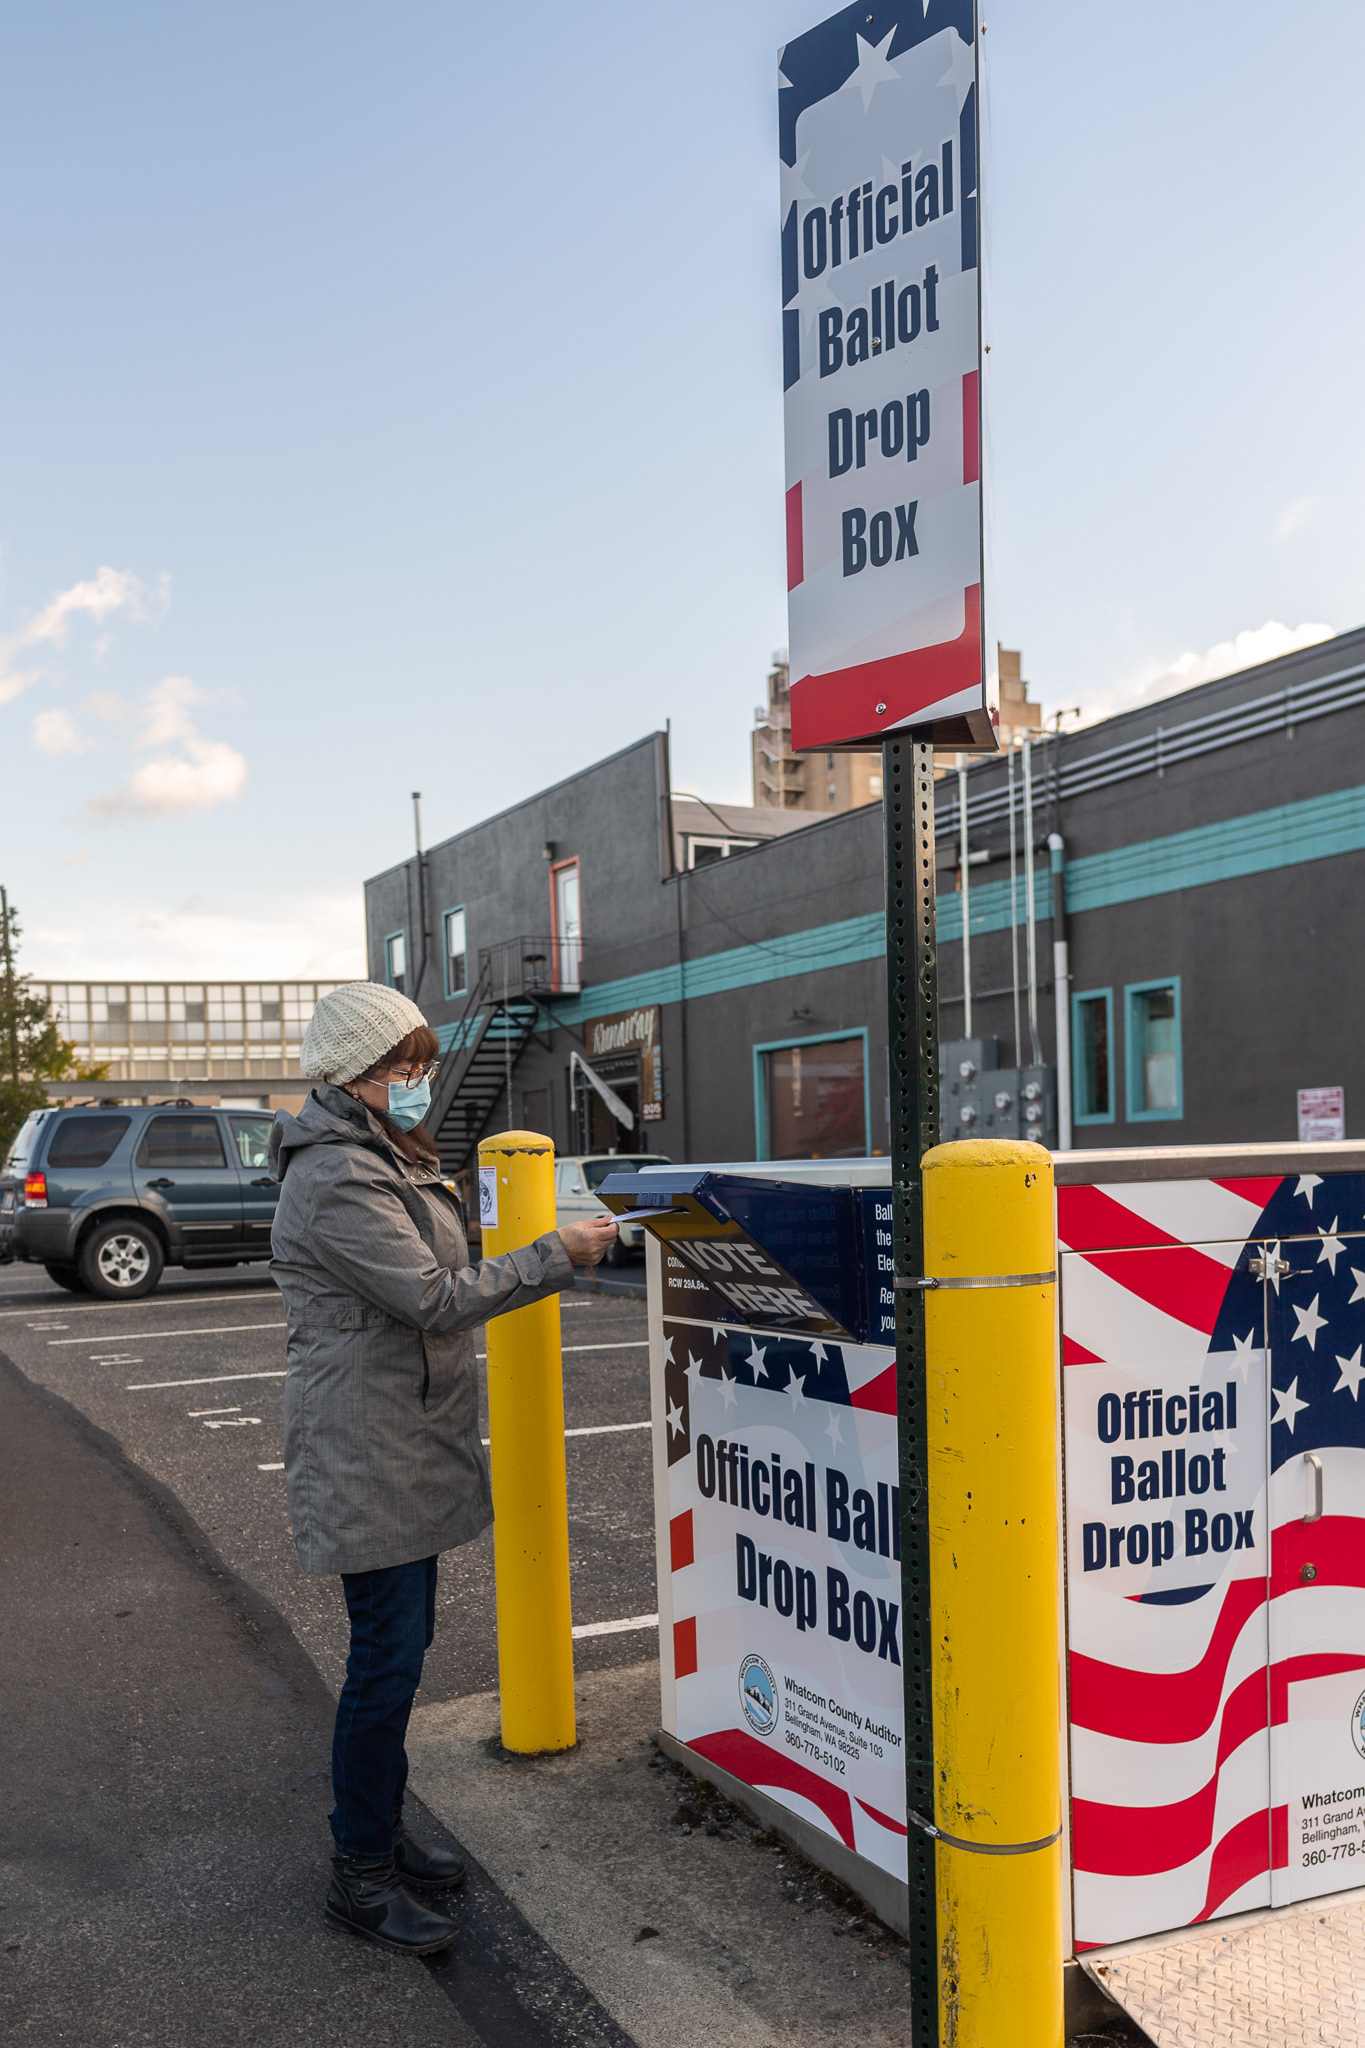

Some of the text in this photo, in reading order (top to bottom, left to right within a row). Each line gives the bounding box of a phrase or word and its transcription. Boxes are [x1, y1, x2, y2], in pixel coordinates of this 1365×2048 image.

[803, 139, 954, 280] Official
[819, 264, 940, 379] Ballot
[828, 388, 930, 479] Drop
[842, 500, 920, 578] Box
[653, 1045, 662, 1100] PRESS
[875, 1204, 893, 1220] Ball
[876, 1229, 892, 1246] the
[668, 1278, 682, 1288] RCW
[669, 1240, 781, 1276] VOTE
[714, 1281, 828, 1320] HERE
[1098, 1382, 1237, 1444] Official
[696, 1434, 901, 1562] Official Ball
[1111, 1448, 1226, 1505] Ballot
[1082, 1508, 1255, 1572] Drop Box
[736, 1532, 902, 1667] Drop Box
[740, 1657, 776, 1694] WHATCOM COUNTY
[744, 1706, 774, 1732] WASHINGTON
[784, 1676, 902, 1748] Whatcom County Auditor
[784, 1698, 883, 1758] 311 Grand Avenue, Suite 103
[784, 1711, 860, 1760] Bellingham, WA 98225
[785, 1730, 846, 1775] 360-778-5102
[1302, 1786, 1365, 1810] Whatcom
[1302, 1816, 1319, 1830] 311
[1323, 1808, 1353, 1825] Grand
[1302, 1824, 1360, 1844] Bellingham,
